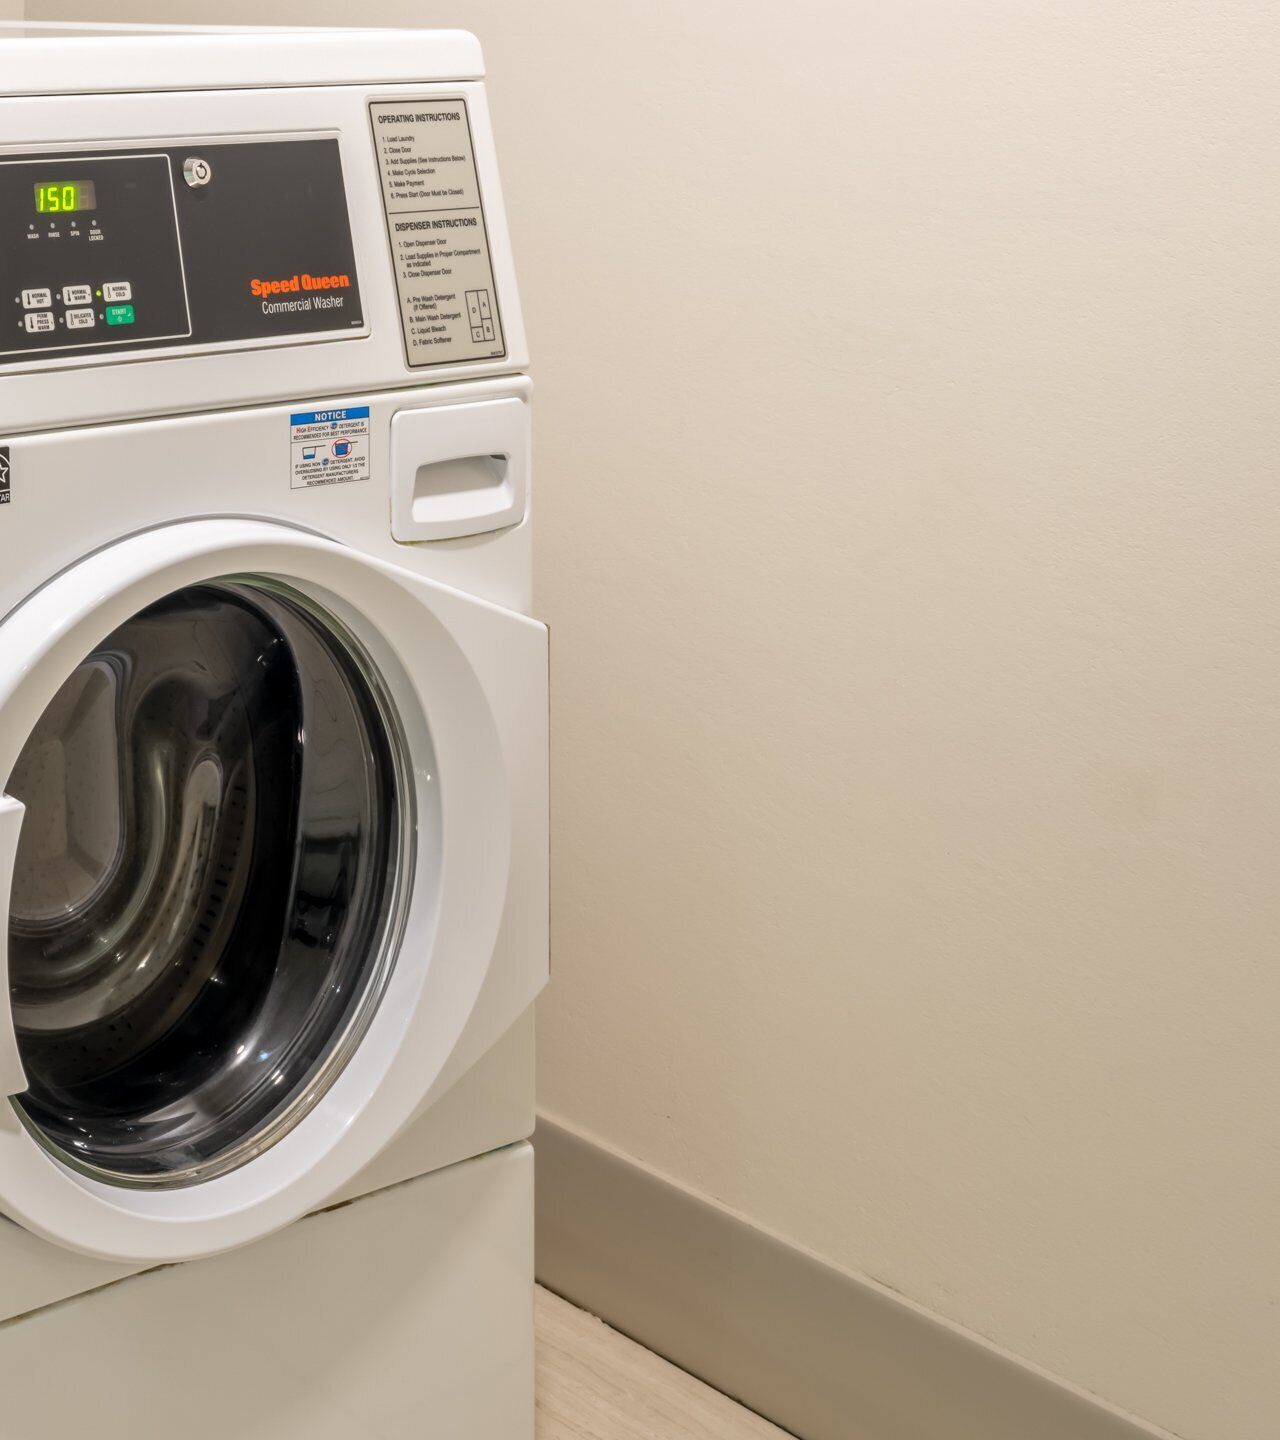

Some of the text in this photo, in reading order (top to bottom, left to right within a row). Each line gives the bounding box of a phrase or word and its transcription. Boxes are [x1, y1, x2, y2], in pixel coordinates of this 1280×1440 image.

[378, 112, 461, 124] OPERATING INSTRUCTIONS
[399, 157, 417, 165] Supplies
[405, 180, 424, 188] Payment
[419, 190, 431, 198] (Door
[395, 217, 477, 232] DISPENSER INSTRUCTIONS
[416, 252, 434, 260] Supplies
[250, 274, 350, 298] Speed Queen
[434, 293, 456, 301] Detergent
[262, 296, 344, 314] Commercial Washer
[419, 303, 437, 311] Offered)
[440, 312, 461, 320] Detergent
[431, 325, 446, 333] Bleach
[315, 410, 347, 421] NOTICE
[293, 427, 367, 440] RECOMMENDED PERFORMANCE
